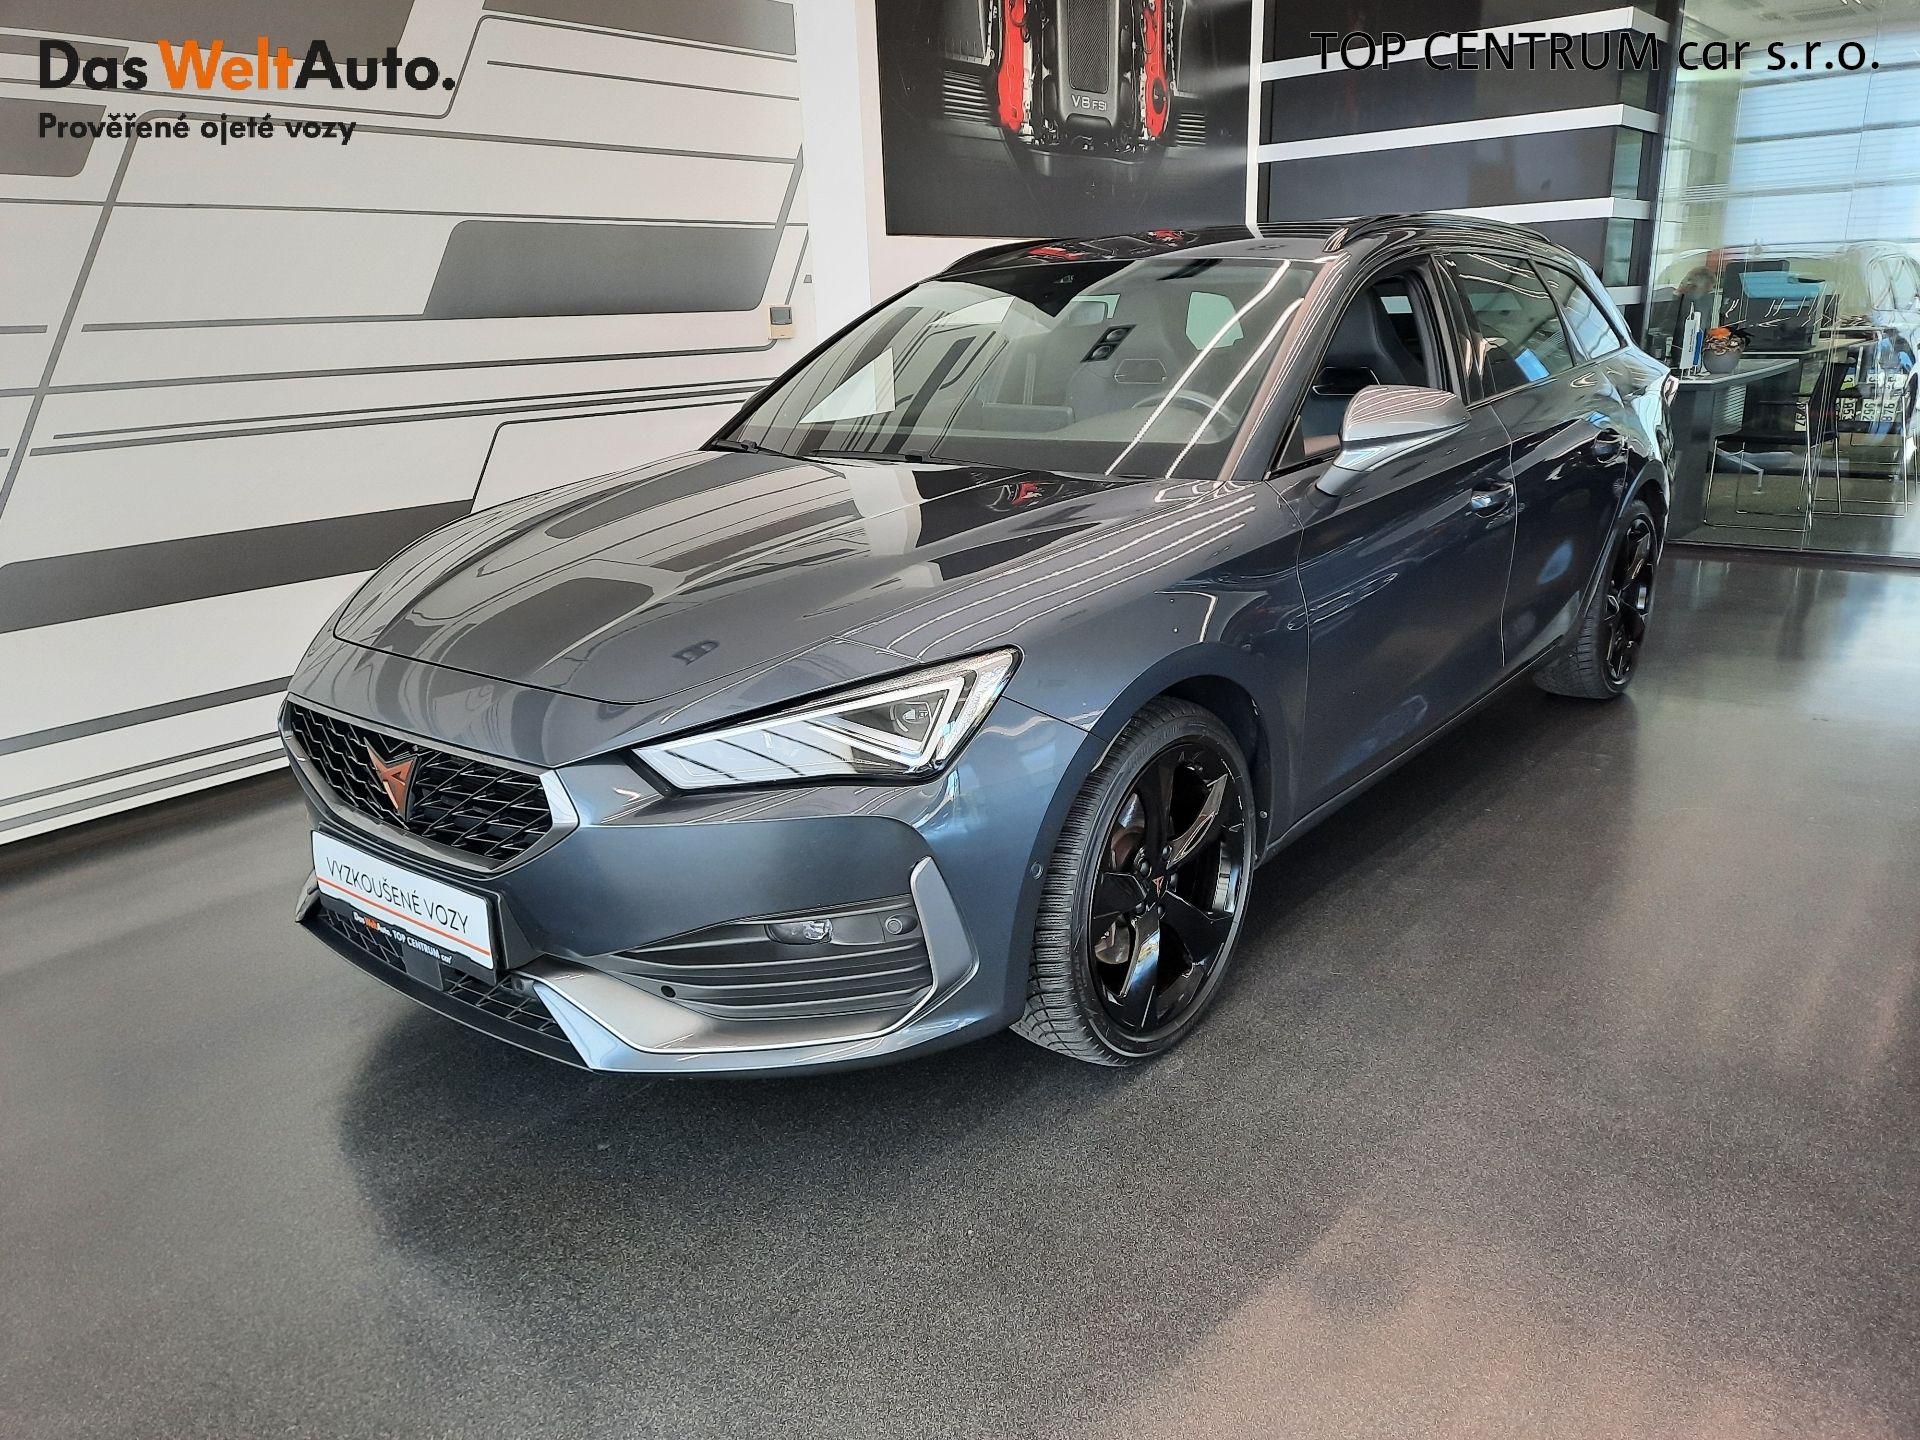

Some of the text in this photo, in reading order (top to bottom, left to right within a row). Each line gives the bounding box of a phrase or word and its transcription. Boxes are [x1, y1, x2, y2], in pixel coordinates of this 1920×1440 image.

[1071, 94, 1107, 111] V8 FSI
[326, 856, 469, 934] VYZKOUŠENÉ VOZY
[392, 930, 406, 943] TOP
[406, 936, 441, 959] CENTRUM
